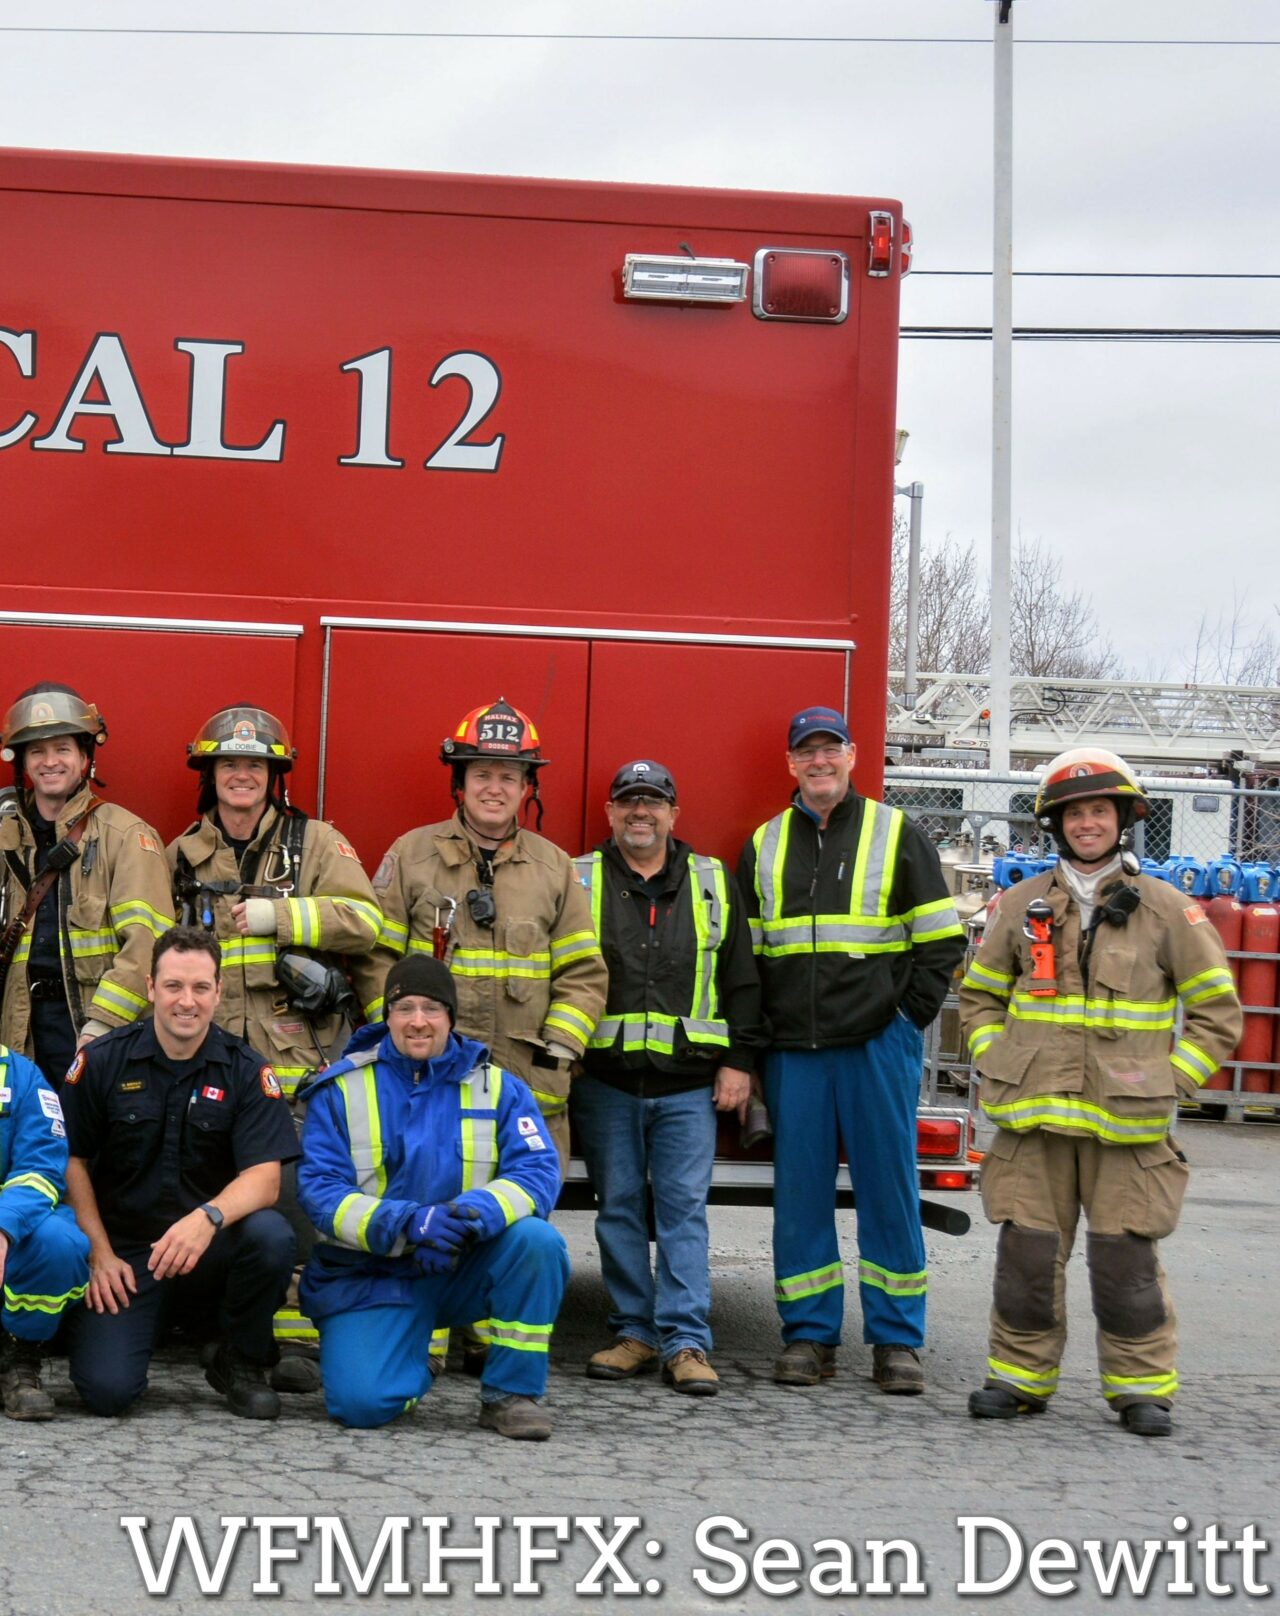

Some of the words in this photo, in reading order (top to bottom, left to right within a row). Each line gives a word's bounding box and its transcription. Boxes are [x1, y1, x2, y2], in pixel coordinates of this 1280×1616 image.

[337, 346, 505, 473] 12
[484, 713, 519, 724] HALIFAX
[479, 723, 520, 743] 512
[234, 743, 258, 752] DOBIE
